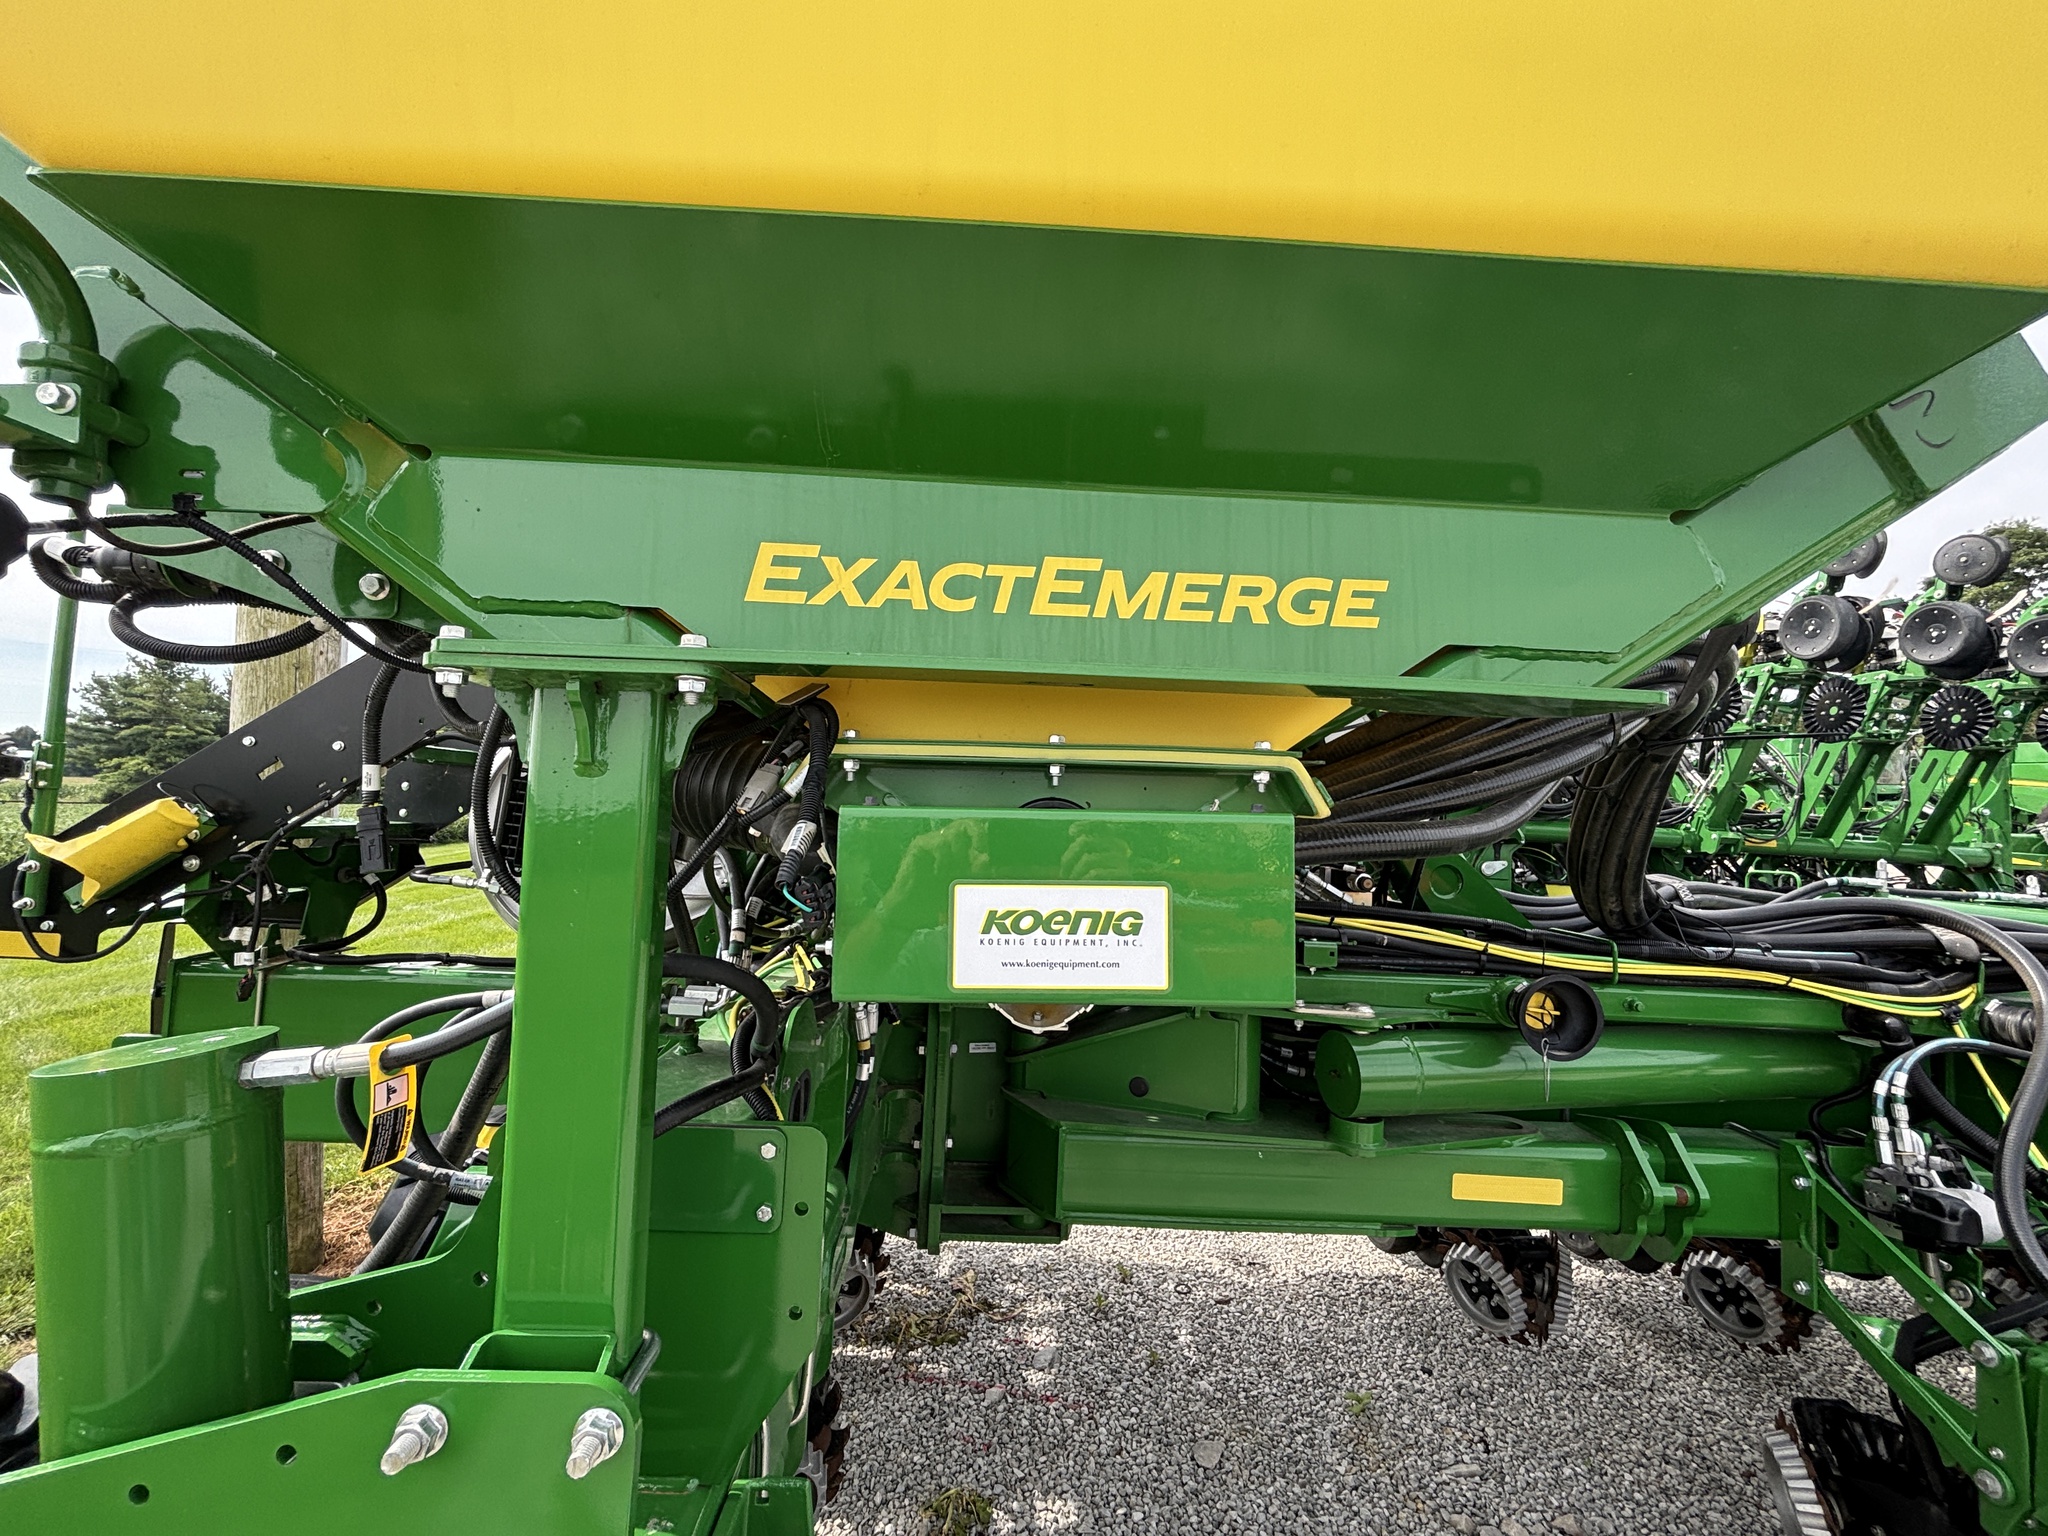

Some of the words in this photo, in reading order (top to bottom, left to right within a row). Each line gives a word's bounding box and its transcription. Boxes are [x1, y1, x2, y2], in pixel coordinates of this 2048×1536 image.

[745, 541, 1390, 629] EXACTEMERGE
[979, 938, 1025, 946] KOENIG
[1033, 938, 1109, 948] EQUIPMENT,
[1117, 939, 1143, 947] INC.
[1001, 959, 1120, 971] www.koenigequipment.com
